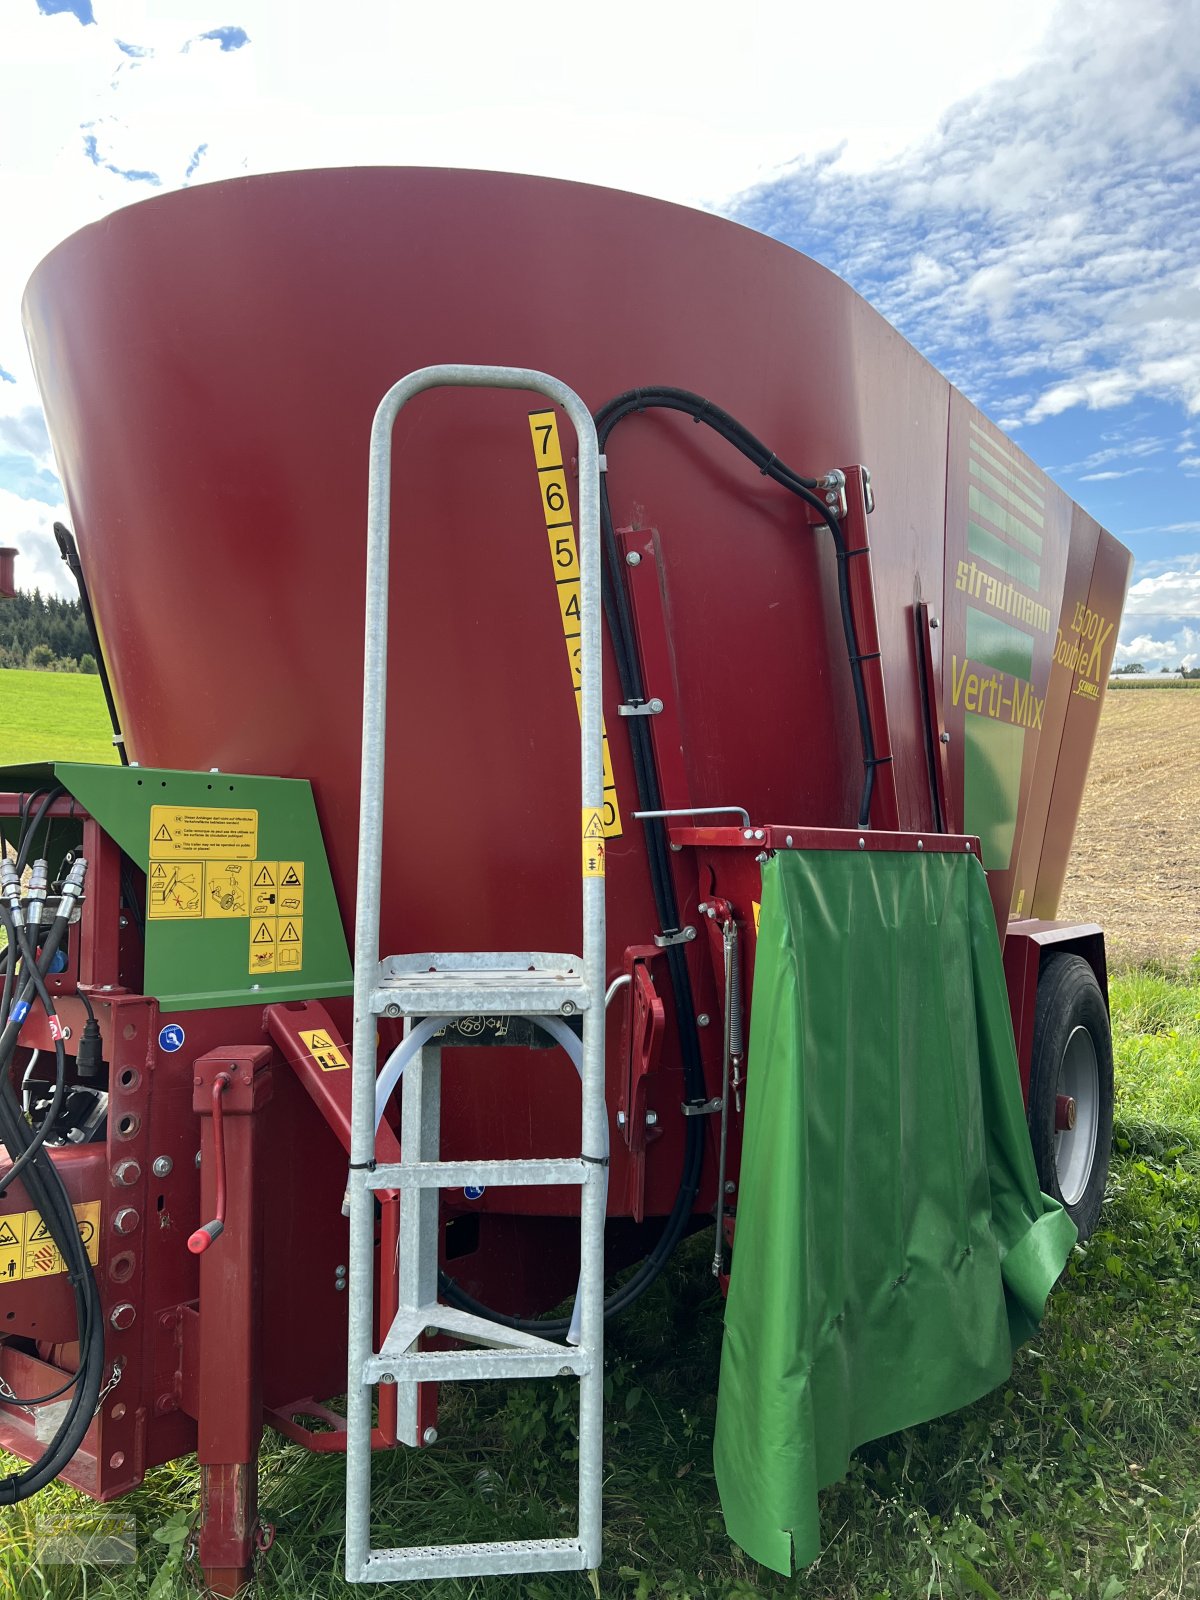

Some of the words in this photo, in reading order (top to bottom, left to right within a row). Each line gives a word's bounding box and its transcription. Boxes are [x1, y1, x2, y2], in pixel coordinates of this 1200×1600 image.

[534, 424, 553, 455] 7
[545, 482, 565, 512] 6
[556, 538, 574, 568] 5
[565, 593, 581, 621] 4
[955, 559, 1051, 634] strautmann
[1070, 601, 1099, 641] 1500
[1085, 617, 1114, 683] K
[951, 654, 1045, 731] Verti-Mix
